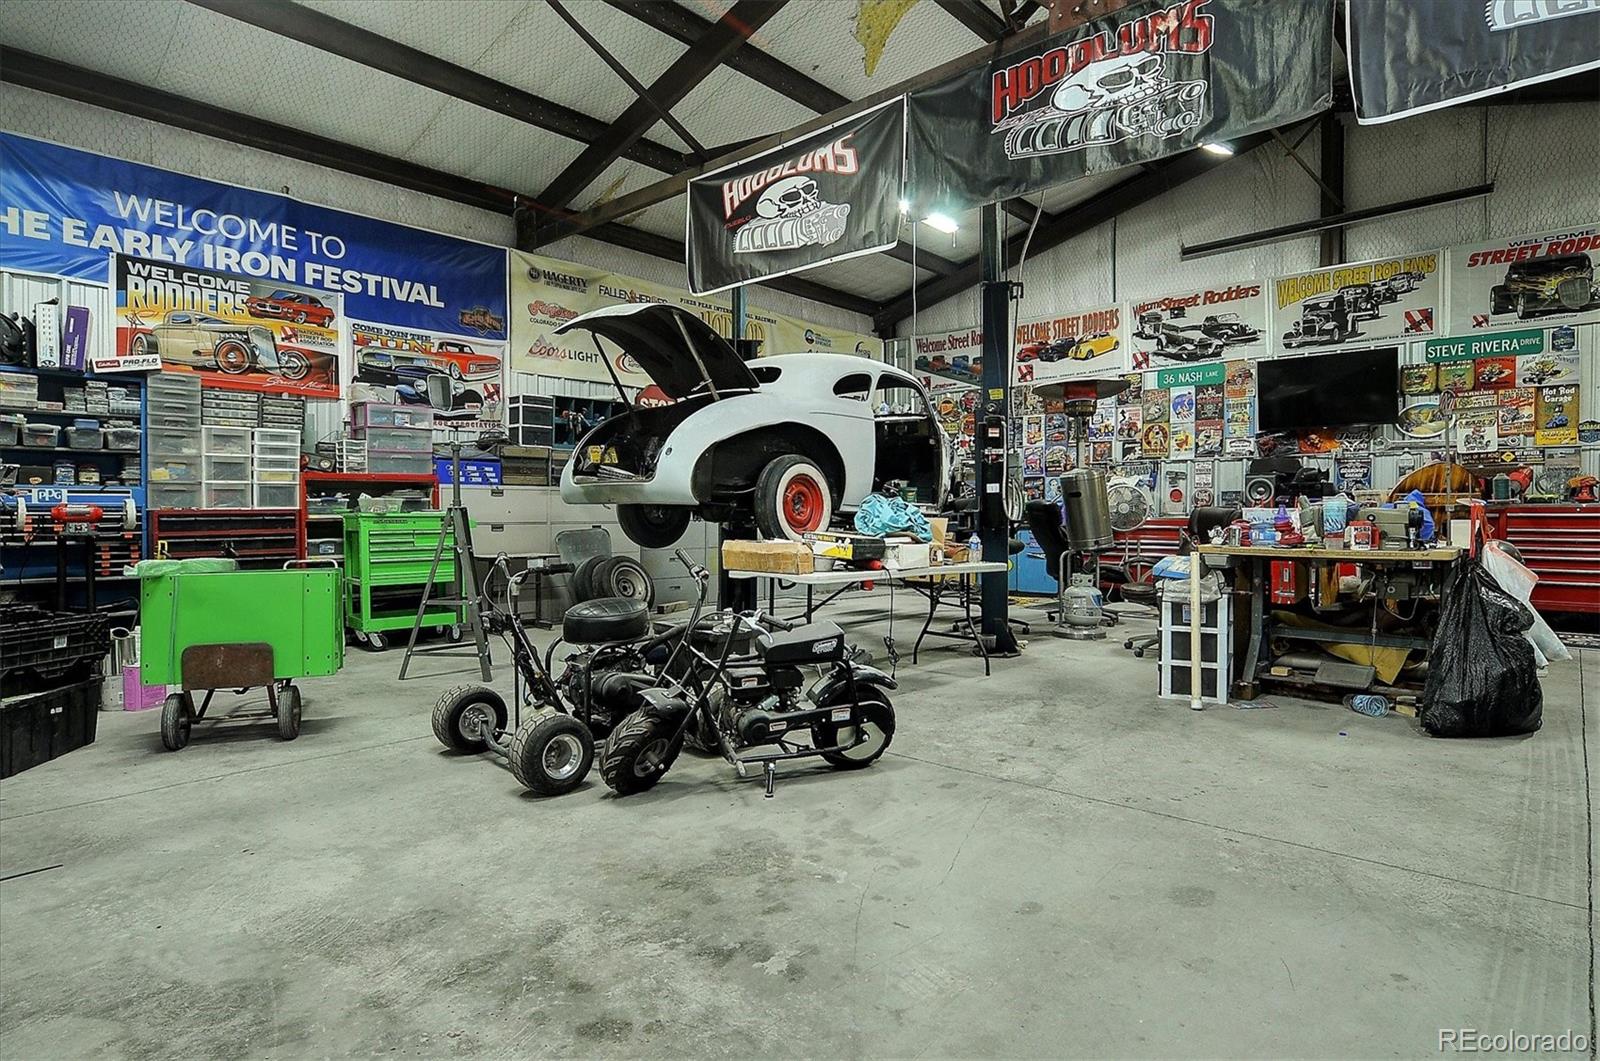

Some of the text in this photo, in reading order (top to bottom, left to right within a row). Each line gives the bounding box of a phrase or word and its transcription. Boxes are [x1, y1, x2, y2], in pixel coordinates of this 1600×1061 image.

[993, 0, 1216, 125] HOODLUMS
[722, 132, 860, 220] HOODLUMS
[114, 191, 346, 259] WELCOME TO
[1508, 229, 1597, 248] WELCOME
[62, 216, 194, 264] EARLY
[204, 243, 297, 282] IRON
[305, 261, 446, 309] FESTIVAL
[1467, 243, 1541, 268] STREET
[126, 260, 251, 294] WELCOME
[542, 269, 588, 288] HAGERTY
[1276, 253, 1437, 310] WELCOME STREET ROD FANS
[126, 274, 251, 317] RODDERS
[599, 284, 630, 303] FALLEN
[1161, 293, 1199, 311] Street
[1203, 283, 1261, 304] Rodders
[352, 323, 432, 342] COME JOIN THE
[529, 317, 558, 327] COLORADO
[1016, 308, 1121, 345] WELCOME STREET RODDERS
[353, 329, 435, 354] FUN
[916, 337, 947, 354] Welcome
[947, 333, 970, 351] Street
[1427, 343, 1466, 358] STEVE
[1472, 338, 1520, 354] RIVERA
[1520, 337, 1541, 346] DRIVE
[122, 358, 158, 366] PRO-FLO
[528, 341, 568, 361] Coors
[568, 349, 600, 364] LIGHT
[1163, 370, 1219, 384] 36 NASH LANE
[1456, 389, 1495, 397] WARNING
[1542, 387, 1557, 396] Hot
[1558, 386, 1575, 395] Rod
[1544, 395, 1573, 403] Garage
[640, 397, 676, 408] STO
[38, 489, 63, 501] PPG
